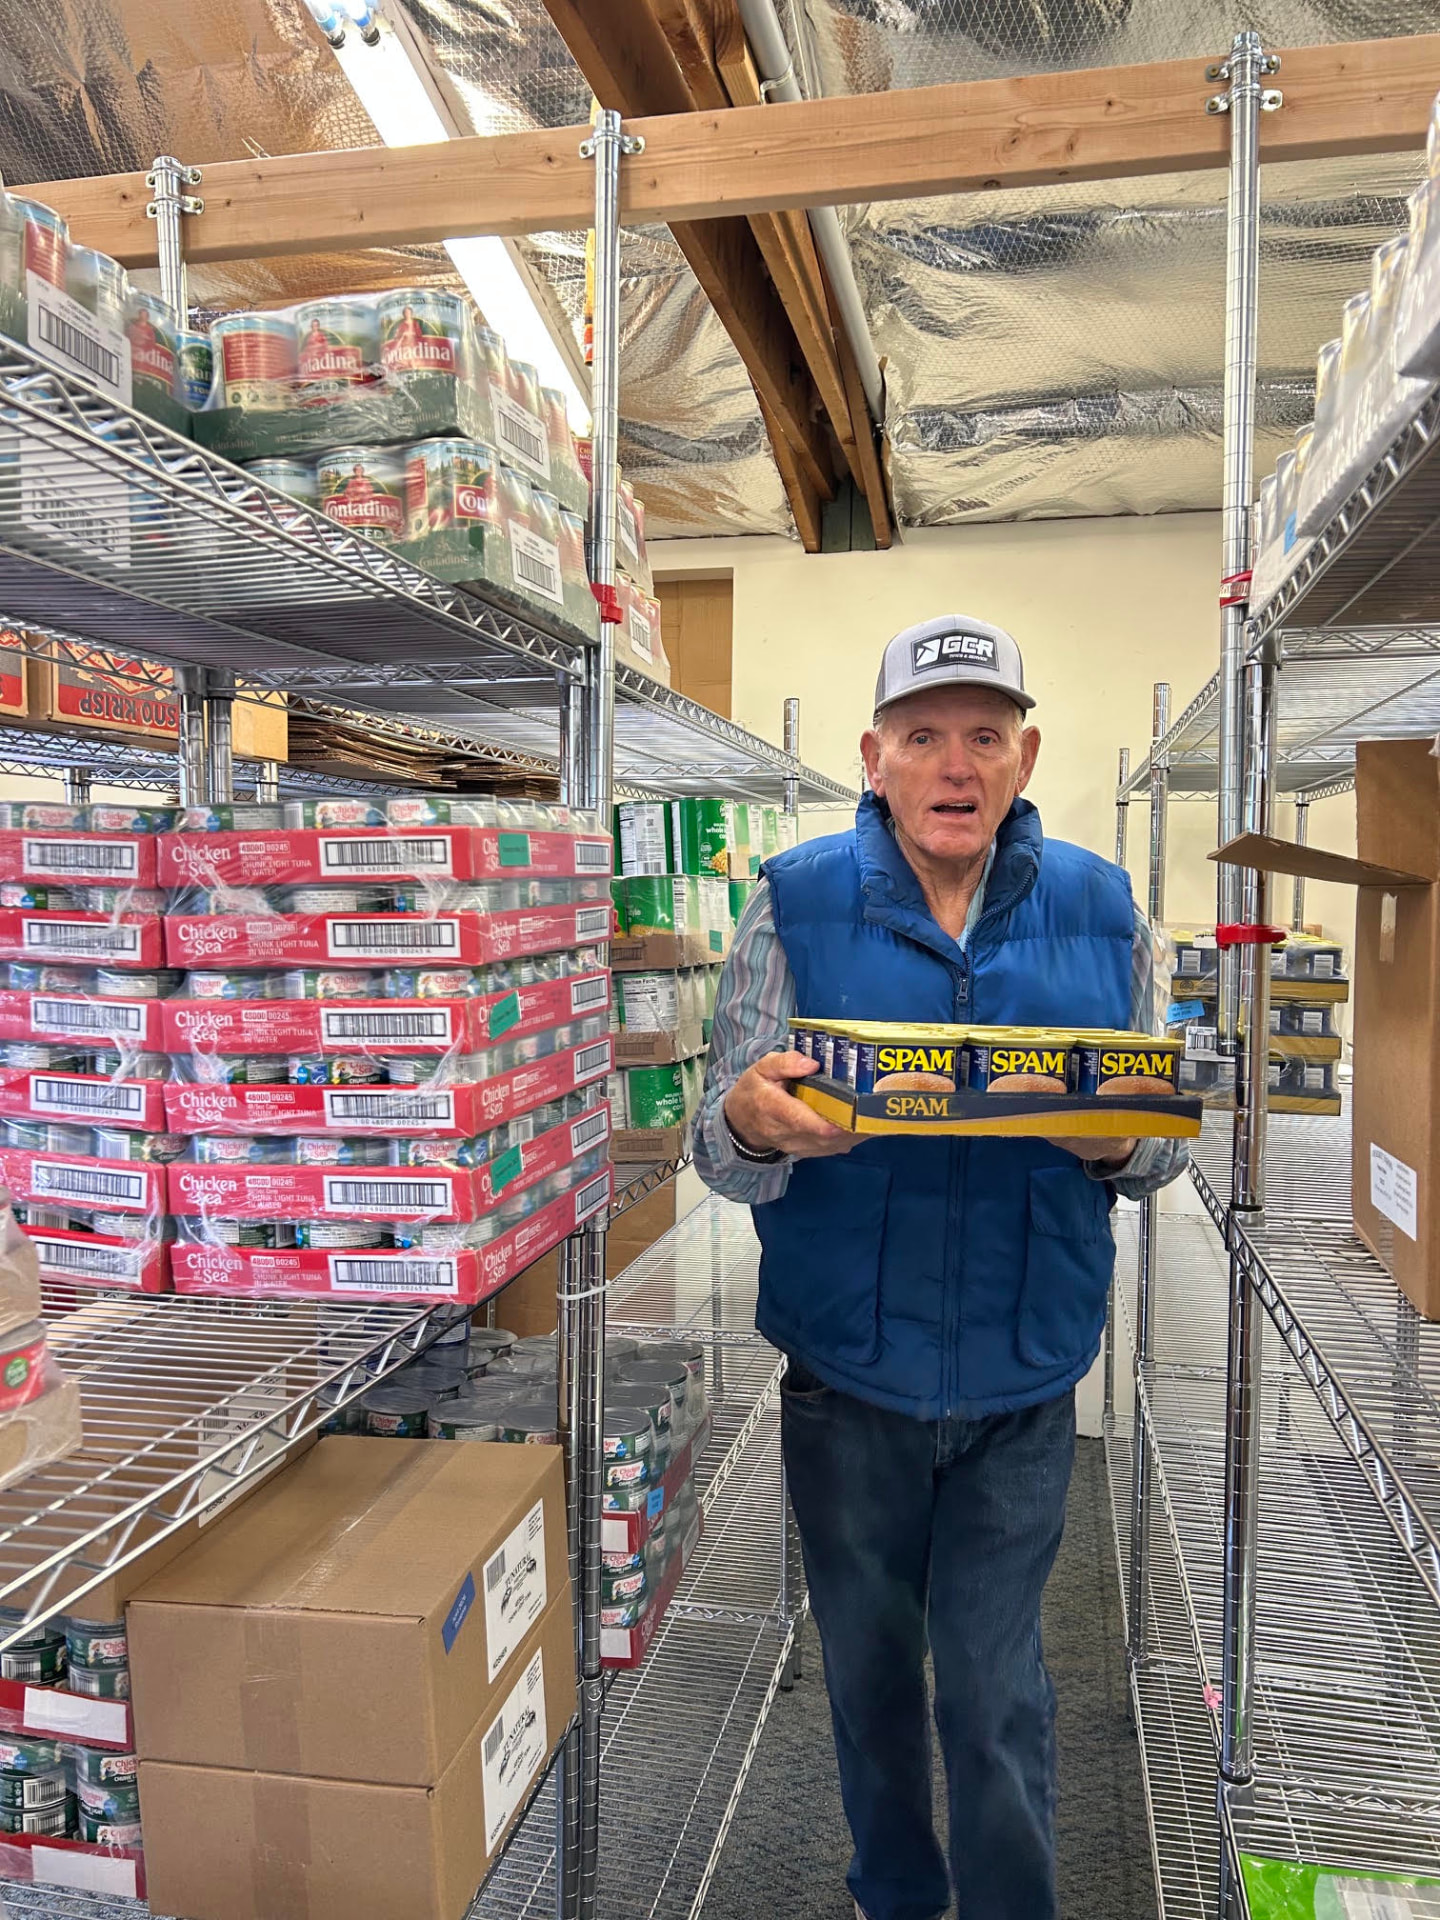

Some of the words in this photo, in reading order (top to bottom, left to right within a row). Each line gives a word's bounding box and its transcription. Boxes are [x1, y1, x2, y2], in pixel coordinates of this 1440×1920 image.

[325, 499, 399, 519] Contadina
[941, 635, 994, 658] GCR
[172, 843, 231, 863] Chicken
[188, 861, 216, 878] Sea
[269, 860, 291, 868] LIGHT
[178, 924, 238, 942] Chicken
[194, 940, 222, 956] Sea
[248, 940, 274, 948] CHUNK
[276, 940, 297, 948] LIGHT
[298, 940, 319, 948] TUNA
[175, 1010, 233, 1029] Chicken
[191, 1027, 218, 1041] Sea
[877, 1047, 955, 1072] SPAM
[991, 1050, 1067, 1074] SPAM
[1101, 1052, 1174, 1076] SPAM
[179, 1092, 237, 1111] Chicken
[271, 1093, 294, 1102] 00245
[482, 1083, 510, 1106] Chicken
[195, 1107, 223, 1122] Sea
[885, 1096, 949, 1117] SPAM
[179, 1175, 237, 1194] Chicken
[274, 1194, 295, 1202] LIGHT
[186, 1253, 243, 1272] Chicken
[485, 1243, 513, 1272] Chicken
[203, 1269, 229, 1284] Sea
